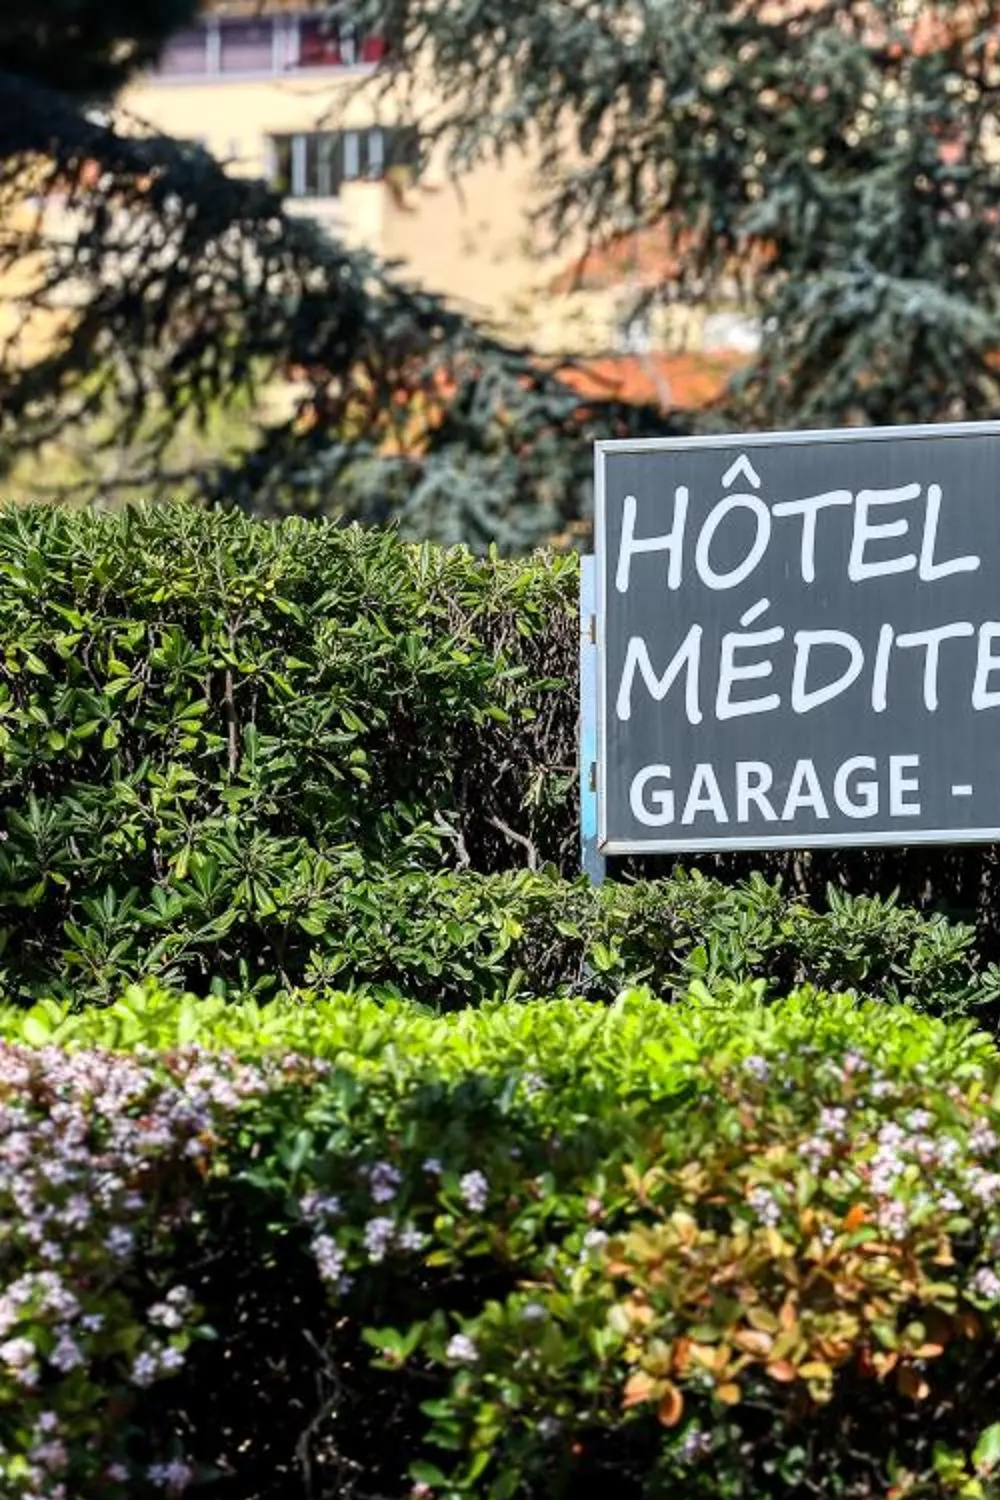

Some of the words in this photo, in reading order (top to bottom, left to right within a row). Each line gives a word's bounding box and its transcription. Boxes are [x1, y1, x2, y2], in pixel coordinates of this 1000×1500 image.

[616, 453, 981, 592] HÔTEL
[629, 755, 922, 828] GARAGE
[951, 784, 974, 798] -
